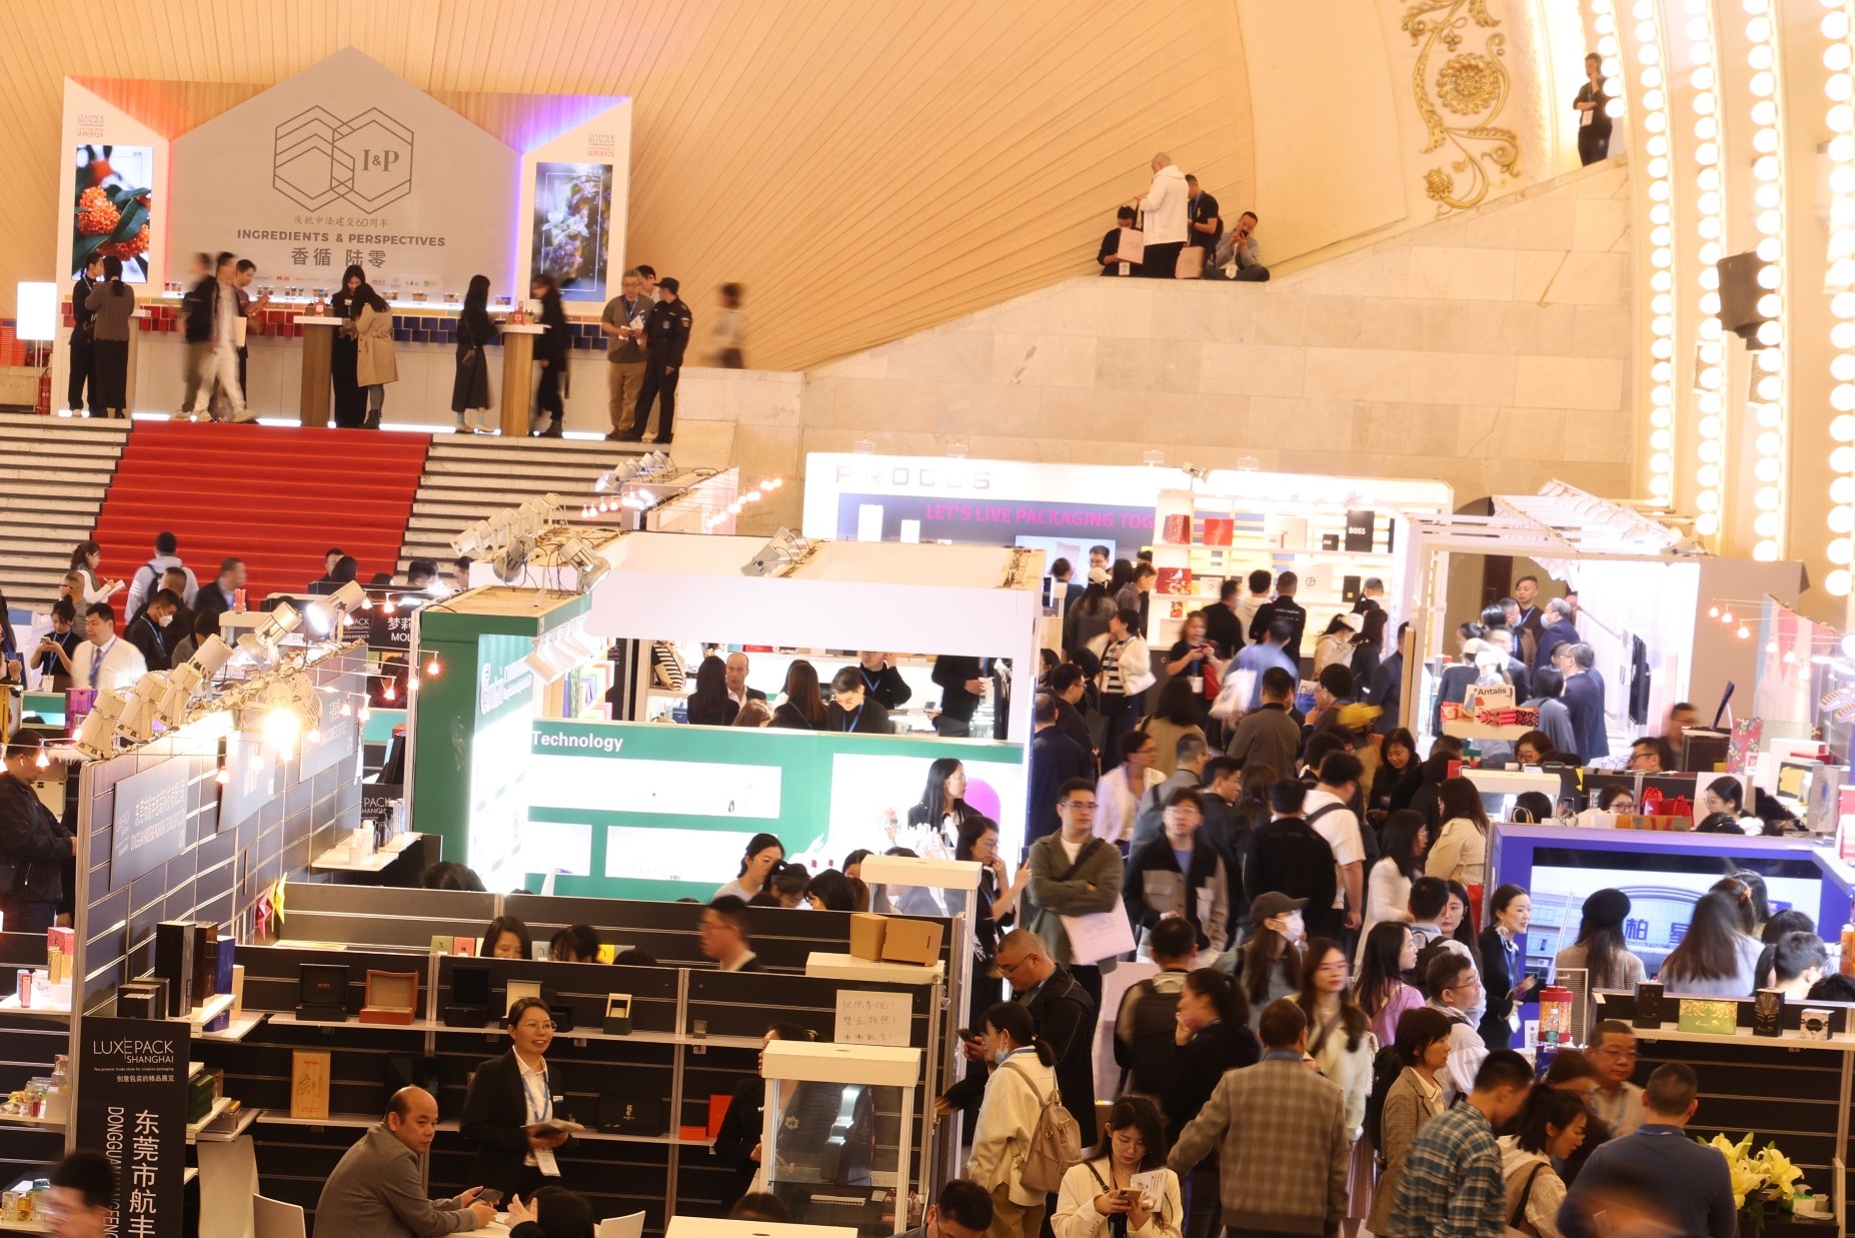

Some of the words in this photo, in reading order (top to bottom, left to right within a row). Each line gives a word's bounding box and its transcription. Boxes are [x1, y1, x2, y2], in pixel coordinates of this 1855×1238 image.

[362, 149, 400, 172] I&P
[294, 215, 389, 228] 庆祝中法建交60周年
[237, 229, 329, 242] INGREDIENTS
[335, 234, 344, 242] &
[348, 233, 446, 247] PERSPECTIVES
[291, 247, 332, 267] 香循
[345, 249, 387, 268] 陆零
[926, 503, 971, 522] LET'S
[975, 506, 1011, 524] LIVE
[1016, 510, 1114, 528] PACKAGING
[1348, 526, 1366, 536] BOSS
[1477, 688, 1507, 697] Antalis
[532, 730, 624, 753] Technology
[93, 1038, 174, 1056] LUXEPACK
[126, 1055, 174, 1064] SHANGHAI
[116, 1074, 175, 1083] 创意包装的精品展览
